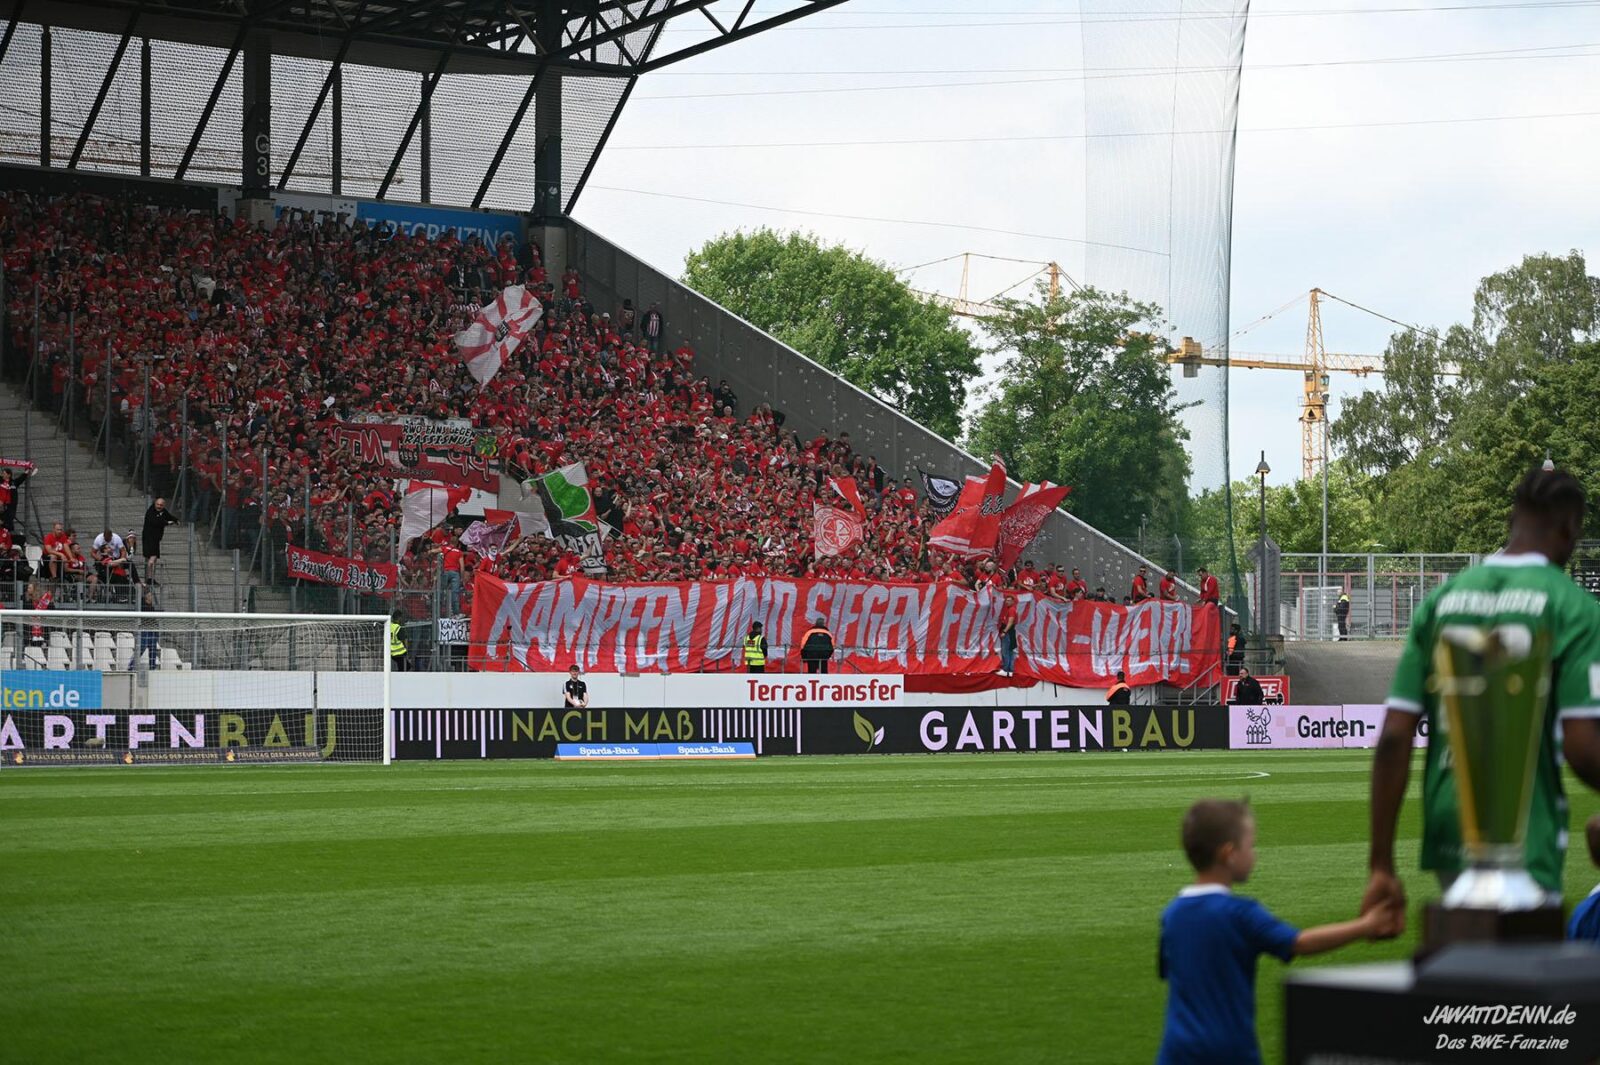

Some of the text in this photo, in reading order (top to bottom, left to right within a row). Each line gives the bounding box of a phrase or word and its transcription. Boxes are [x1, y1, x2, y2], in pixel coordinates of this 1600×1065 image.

[257, 156, 268, 176] 3
[404, 434, 475, 447] RASSISMUS
[704, 575, 798, 668] UND
[805, 581, 937, 669] SIEGEN
[0, 684, 80, 708] ten.de
[747, 678, 902, 701] TerraTransfer
[512, 710, 607, 742] NACH
[919, 709, 1196, 751] GARTENBAU
[1297, 714, 1376, 739] Garten-
[579, 745, 640, 756] Sparda-Bank
[677, 744, 736, 755] Sparda-Bank
